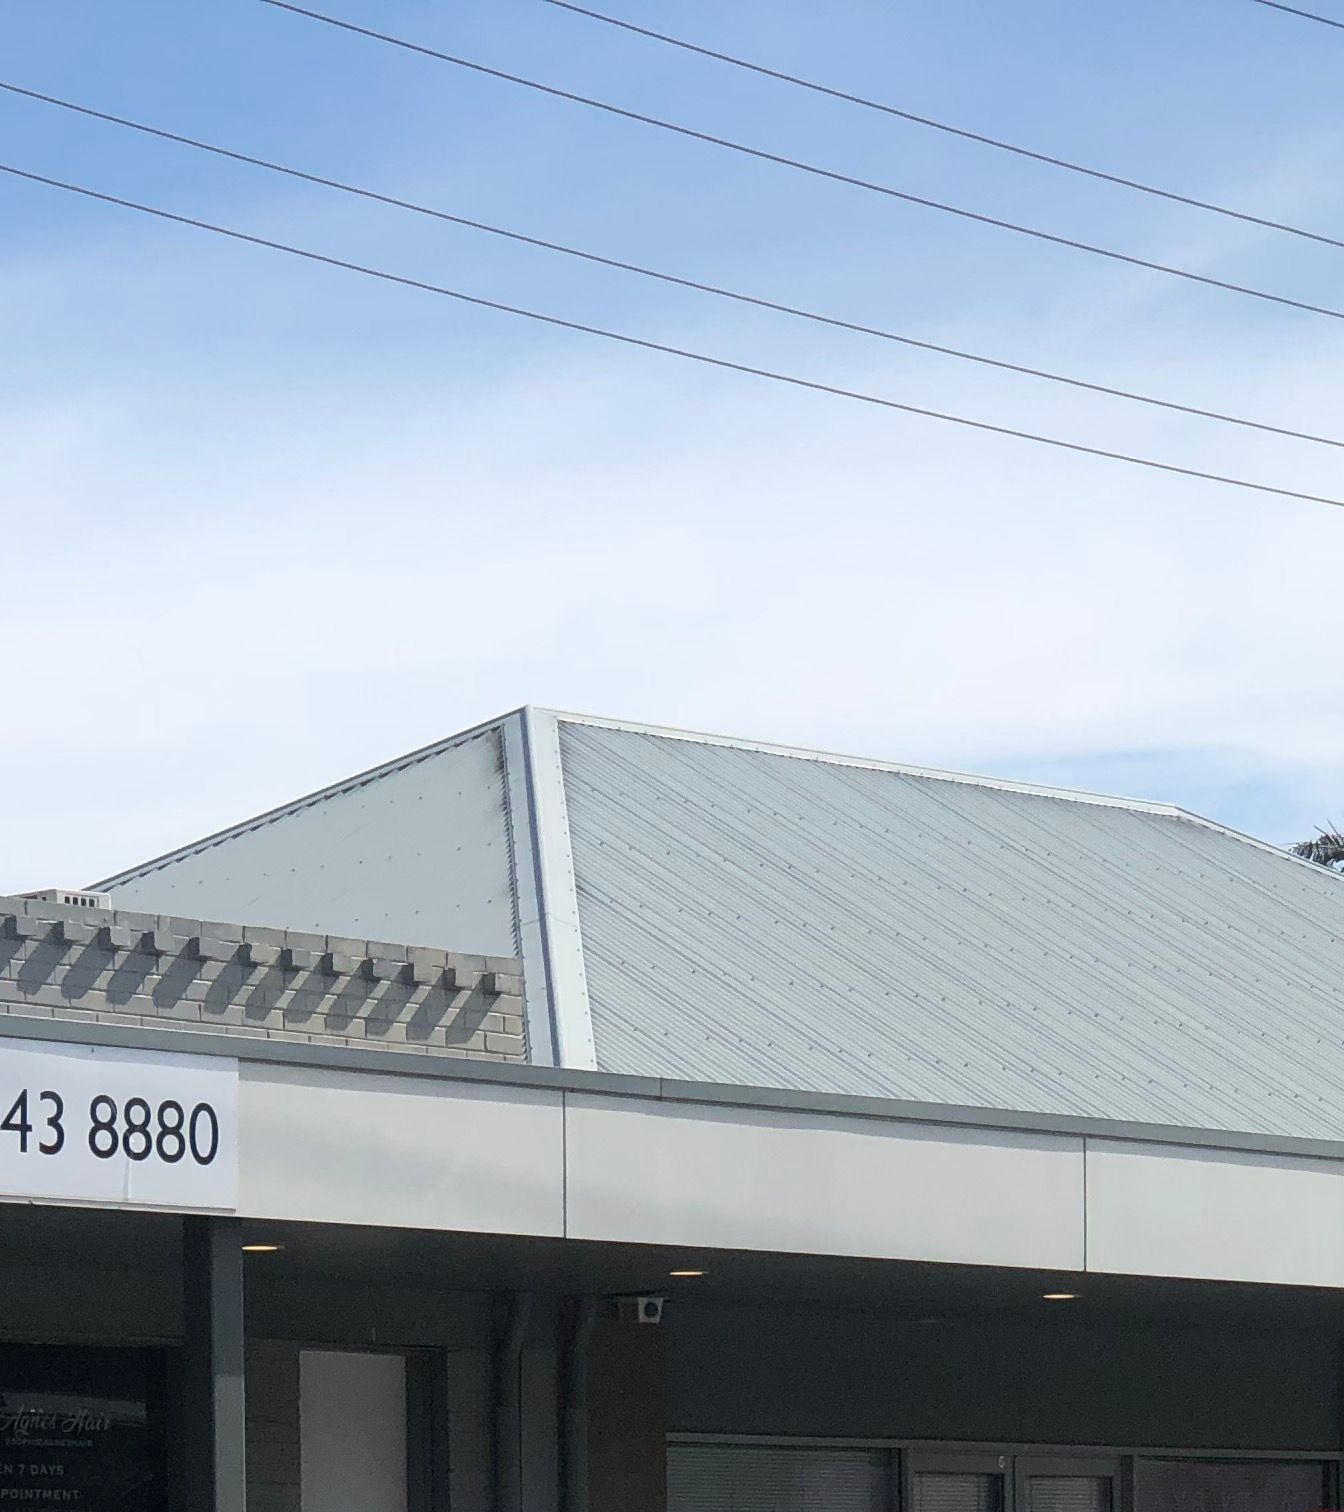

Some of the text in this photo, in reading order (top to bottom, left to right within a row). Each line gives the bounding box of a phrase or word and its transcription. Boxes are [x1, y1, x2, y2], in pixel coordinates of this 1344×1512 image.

[88, 1094, 220, 1166] 8880
[18, 1464, 26, 1475] 7
[30, 1464, 65, 1476] DAYS
